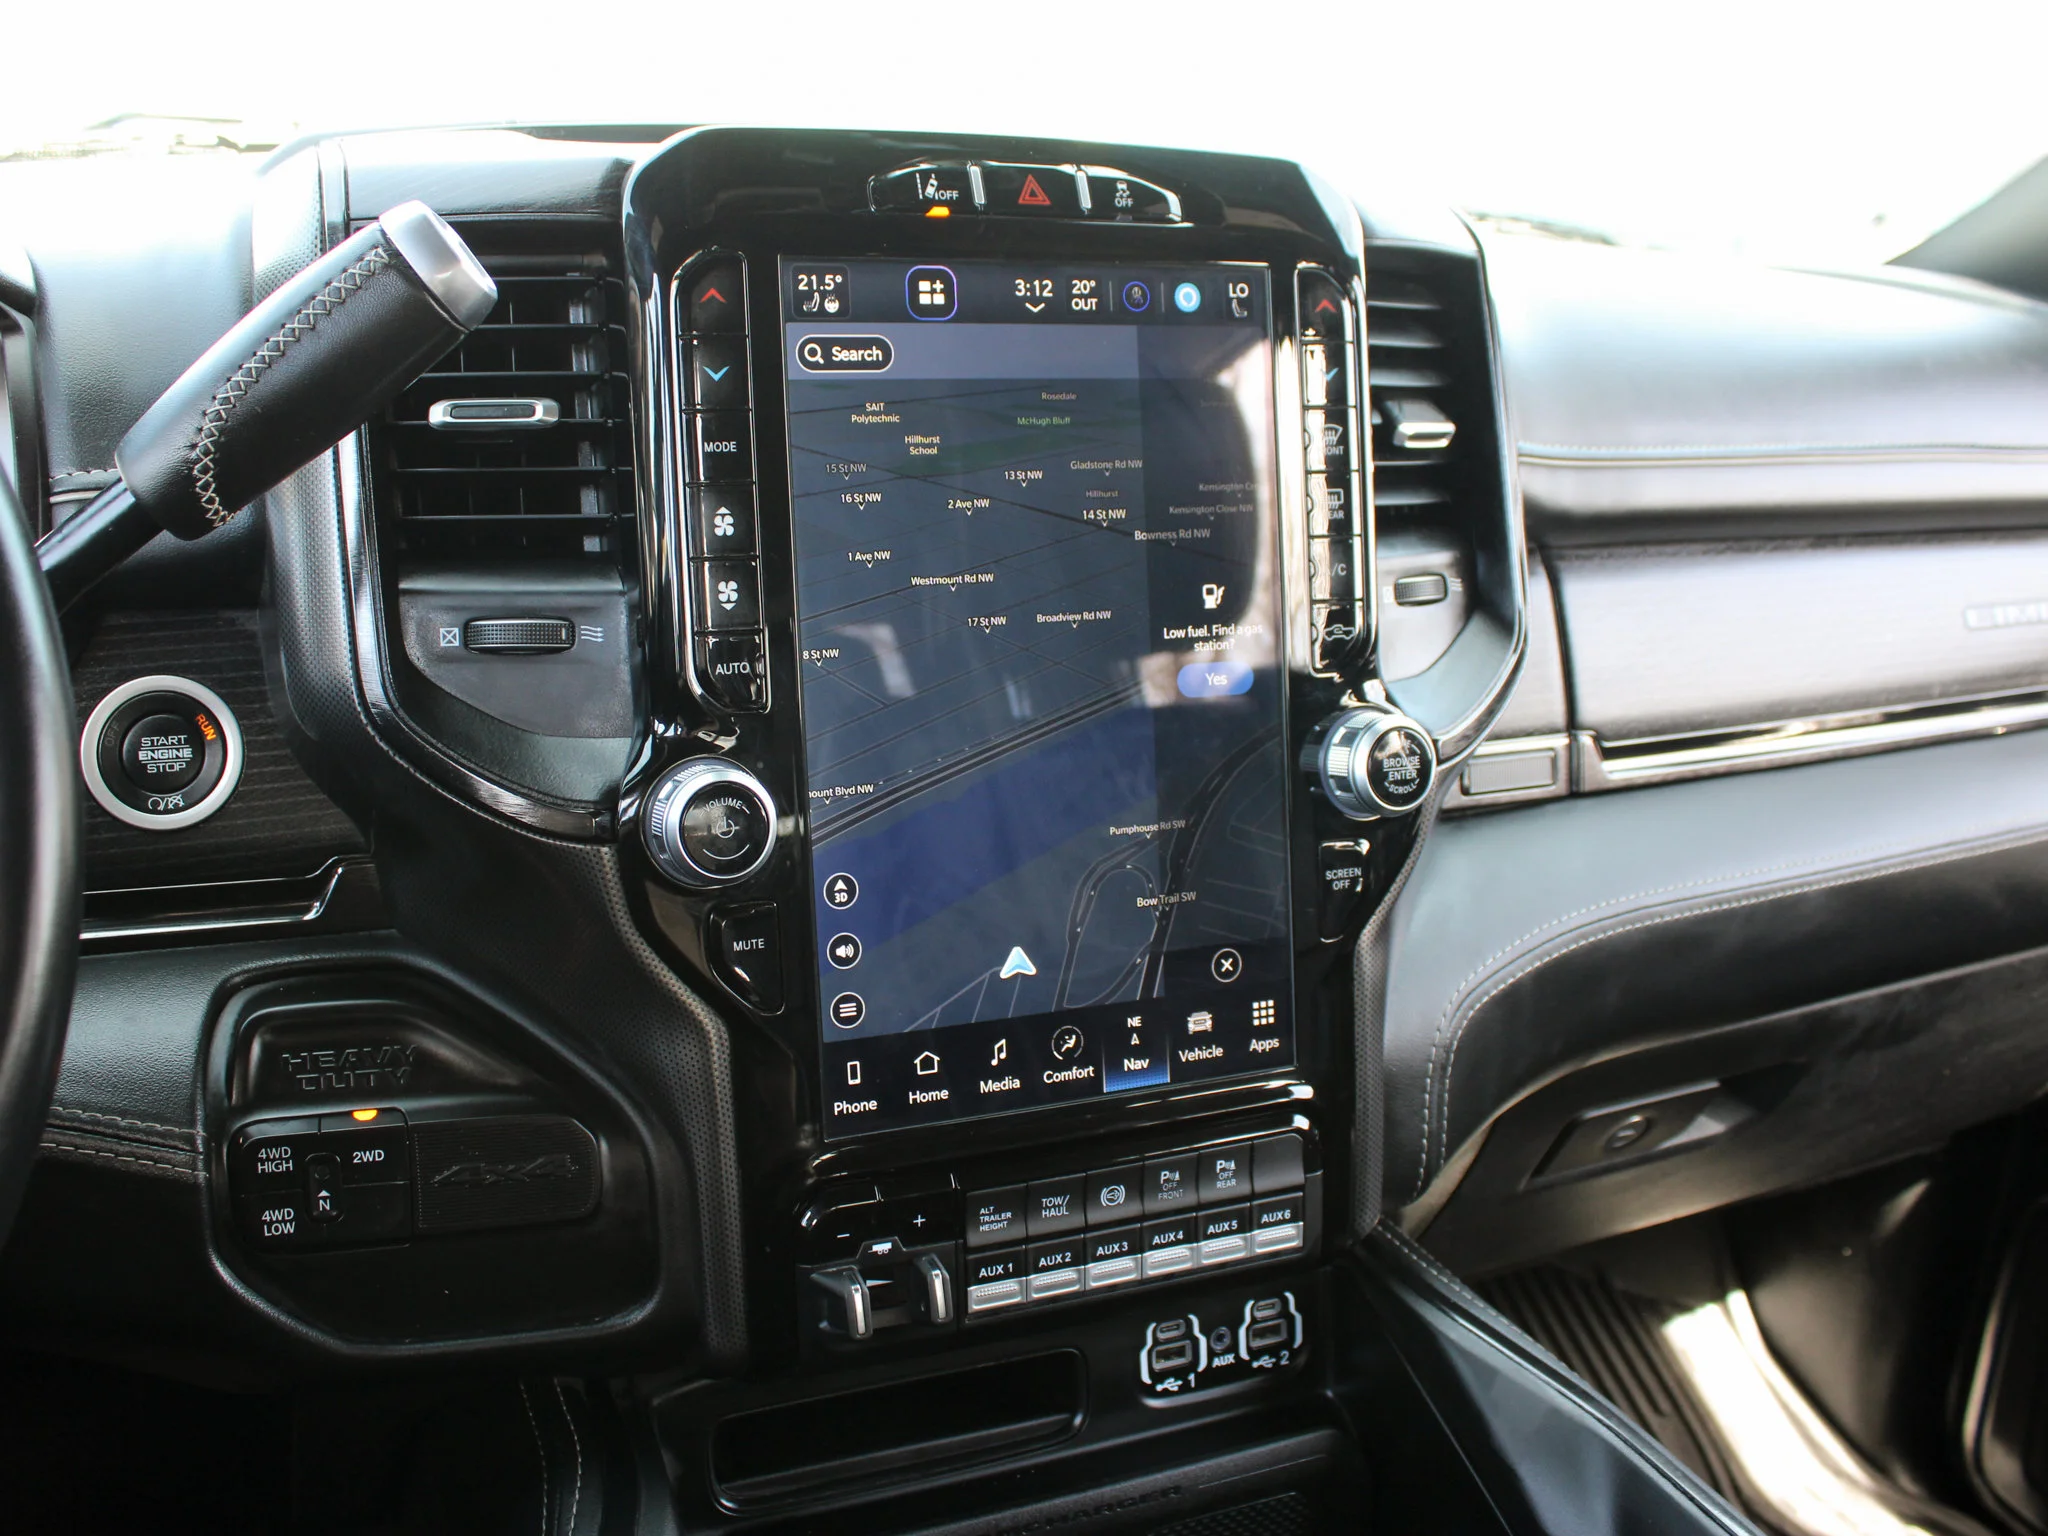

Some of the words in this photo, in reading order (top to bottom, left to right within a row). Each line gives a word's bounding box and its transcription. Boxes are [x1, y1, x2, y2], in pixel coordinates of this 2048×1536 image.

[939, 190, 959, 200] OFF
[1114, 197, 1133, 208] OFF
[1015, 279, 1053, 297] 3:12
[1072, 279, 1096, 295] 20°
[1228, 282, 1249, 298] LO
[1071, 298, 1098, 311] OUT
[831, 345, 883, 361] Search
[1041, 391, 1077, 401] Rosedale
[865, 402, 885, 412] SAIT
[851, 413, 900, 425] Polytechnic
[1017, 416, 1051, 427] McHugh
[1052, 416, 1071, 425] Bluff
[904, 435, 941, 445] Hillhurst
[704, 441, 737, 453] MODE
[909, 446, 938, 456] School
[825, 464, 837, 474] 15
[838, 464, 848, 473] St
[849, 463, 867, 473] NW
[1070, 460, 1113, 471] Gladstone
[1115, 459, 1127, 469] Rd
[1128, 459, 1143, 468] NW
[1004, 471, 1015, 480] 13
[1016, 470, 1026, 479] St
[1027, 470, 1043, 480] NW
[841, 493, 853, 503] 16
[853, 494, 864, 503] St
[864, 492, 882, 502] NW
[948, 500, 954, 508] 2
[955, 499, 972, 508] Ave
[973, 499, 990, 508] NW
[1082, 510, 1096, 520] 14
[1096, 509, 1107, 519] St
[1108, 509, 1127, 518] NW
[1169, 504, 1214, 516] Kensington
[1134, 531, 1177, 541] Bowness
[1179, 529, 1192, 539] Rd
[1193, 529, 1211, 539] NW
[854, 552, 873, 561] Ave
[874, 551, 891, 560] NW
[911, 575, 963, 585] Westmount
[964, 574, 977, 583] Rd
[978, 573, 994, 582] NW
[967, 618, 980, 627] 17
[980, 617, 991, 626] St
[991, 616, 1007, 625] NW
[1036, 613, 1082, 623] Broadview
[1083, 611, 1095, 620] Rd
[1096, 610, 1112, 619] NW
[1163, 627, 1186, 639] Low
[1187, 624, 1211, 638] fuel.
[1212, 623, 1235, 636] Find
[1237, 625, 1243, 635] a
[1244, 624, 1263, 636] gas
[1194, 638, 1235, 652] station?
[811, 650, 821, 659] St
[822, 648, 840, 658] NW
[715, 662, 750, 675] AUTO
[1205, 672, 1228, 686] Yes
[195, 713, 217, 741] RUN
[141, 735, 187, 747] START
[138, 748, 193, 760] ENGINE
[147, 762, 186, 773] STOP
[1382, 755, 1420, 769] BROWSE
[1389, 770, 1417, 780] ENTER
[835, 786, 855, 796] Blvd
[857, 784, 873, 794] NW
[1389, 782, 1416, 794] SCROLL
[702, 797, 743, 812] VOLUME
[1110, 824, 1159, 835] Pumphouse
[1160, 821, 1171, 830] Rd
[1172, 820, 1186, 829] SW
[1325, 868, 1362, 880] SCREEN
[1333, 879, 1350, 890] OFF
[834, 893, 848, 903] 3D
[1137, 897, 1158, 907] Bow
[1159, 895, 1180, 905] Trail
[1181, 892, 1197, 902] SW
[733, 939, 765, 952] MUTE
[1127, 1016, 1142, 1028] NE
[1250, 1037, 1280, 1052] Apps
[281, 1044, 418, 1072] HEAVY
[1179, 1045, 1223, 1062] Vehicle
[1123, 1058, 1149, 1072] Nav
[1043, 1065, 1095, 1084] Comfort
[979, 1076, 1021, 1094] Media
[908, 1087, 949, 1104] Home
[833, 1099, 878, 1116] Phone
[258, 1146, 291, 1160] 4WD
[352, 1149, 385, 1164] 2WD
[257, 1160, 293, 1174] HIGH
[1218, 1171, 1234, 1180] OFF
[1162, 1181, 1178, 1191] OFF
[1216, 1178, 1237, 1189] REAR
[1041, 1195, 1070, 1208] TOW/
[1158, 1189, 1184, 1201] FRONT
[319, 1199, 330, 1211] N
[979, 1206, 995, 1215] ALT
[261, 1208, 295, 1222] 4WD
[979, 1211, 1012, 1223] TRAILER
[1041, 1206, 1069, 1219] HAUL
[1260, 1214, 1284, 1224] AUX
[1284, 1209, 1292, 1220] 6
[264, 1222, 296, 1237] LOW
[979, 1221, 1008, 1232] HEIGHT
[1206, 1224, 1230, 1236] AUX
[1231, 1220, 1238, 1231] 5
[1152, 1235, 1176, 1246] AUX
[1176, 1231, 1184, 1242] 4
[1096, 1245, 1120, 1257] AUX
[1121, 1242, 1128, 1253] 3
[1038, 1256, 1063, 1269] AUX
[1064, 1252, 1072, 1264] 2
[978, 1266, 1004, 1279] AUX
[1007, 1263, 1013, 1274] 1
[1212, 1354, 1236, 1368] AUX
[1280, 1350, 1290, 1365] 2
[1187, 1372, 1196, 1388] 1
